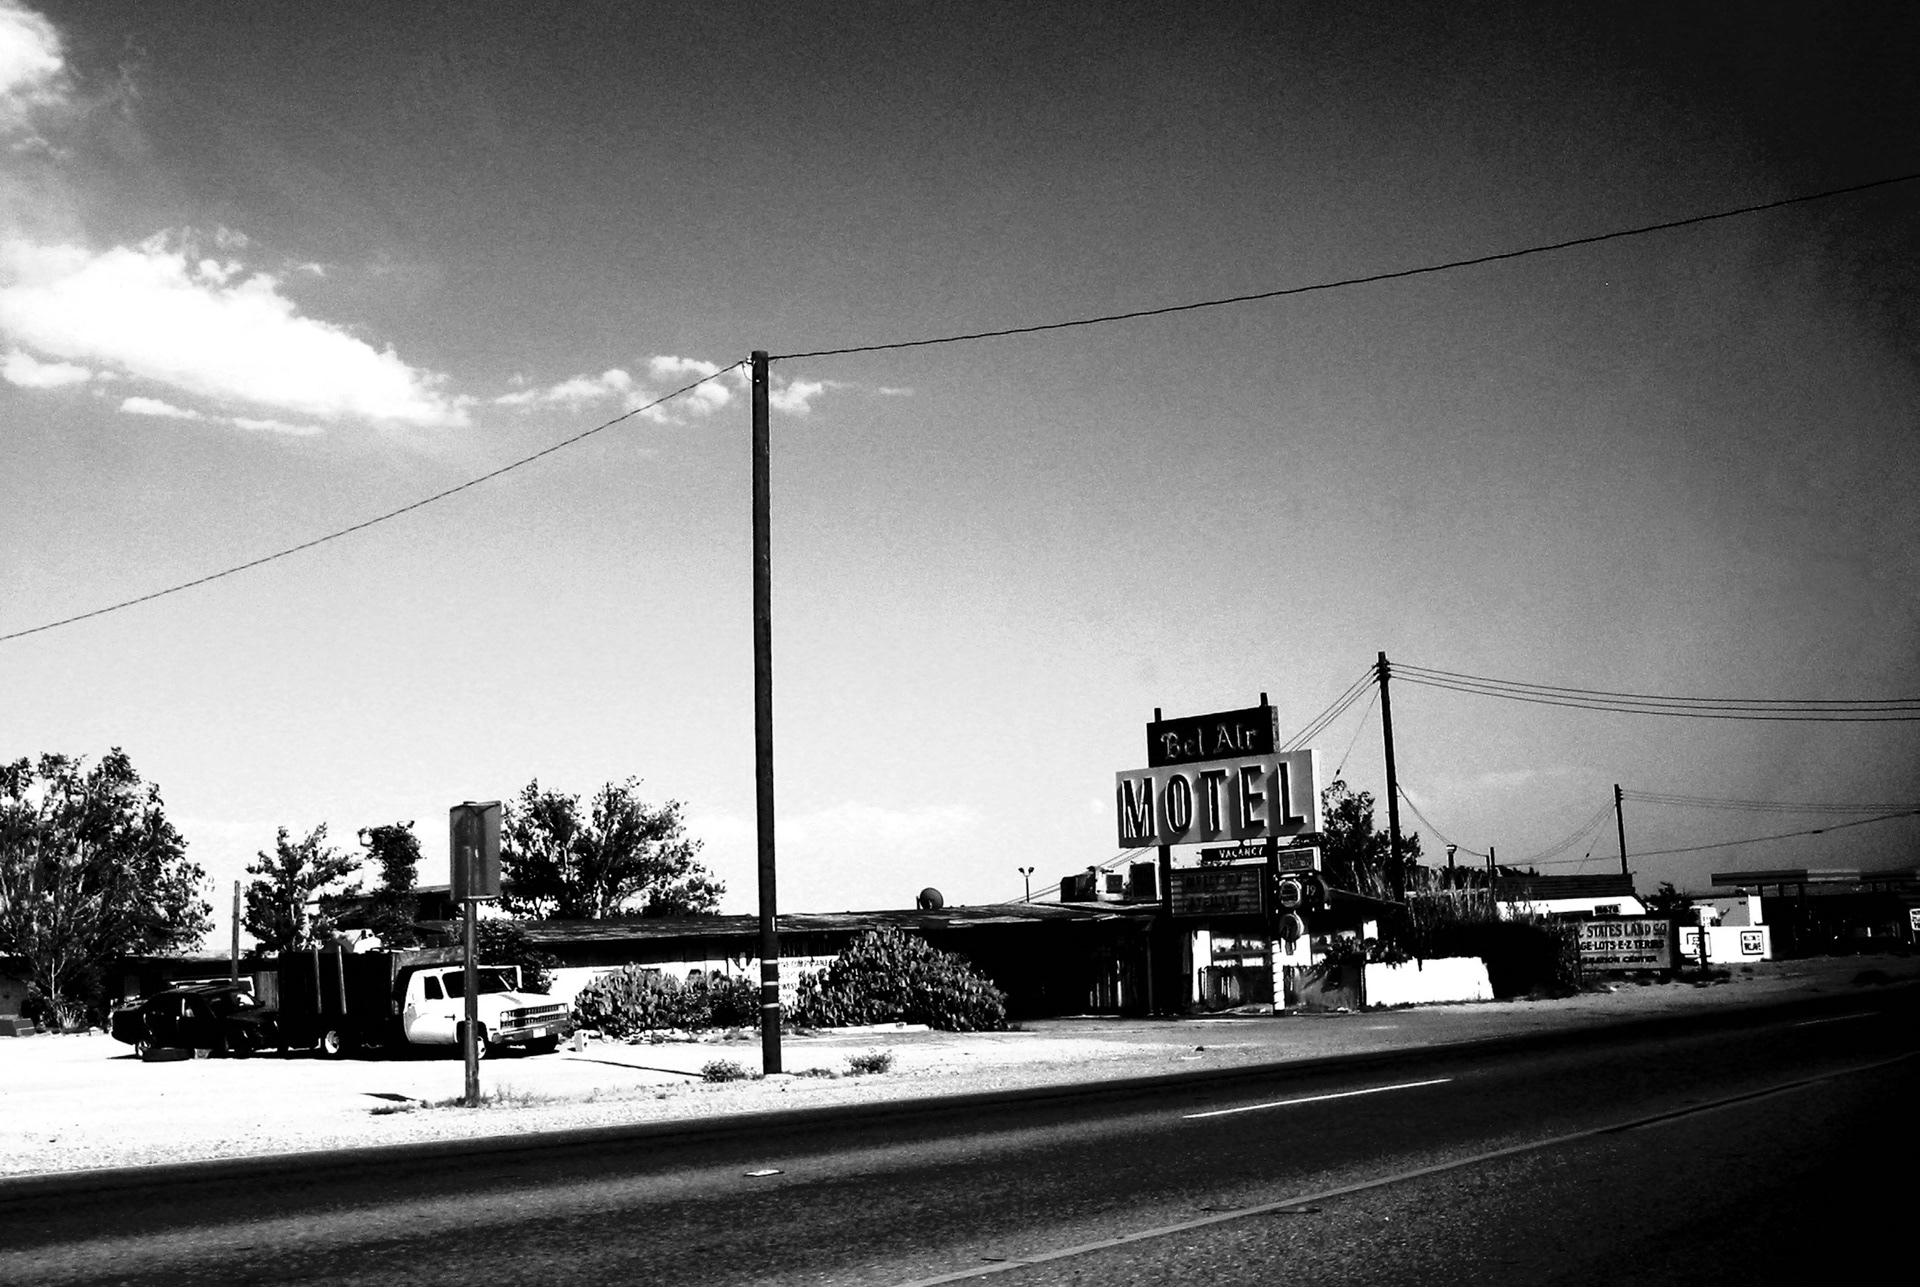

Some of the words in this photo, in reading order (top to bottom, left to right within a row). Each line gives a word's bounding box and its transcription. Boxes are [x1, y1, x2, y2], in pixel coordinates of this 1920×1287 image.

[1160, 727, 1204, 759] Bel
[1121, 761, 1307, 839] MOTEL
[1218, 846, 1264, 859] VACANCY
[1586, 923, 1622, 938] STATES
[1624, 921, 1652, 937] LAND
[1634, 939, 1665, 950] TERMS
